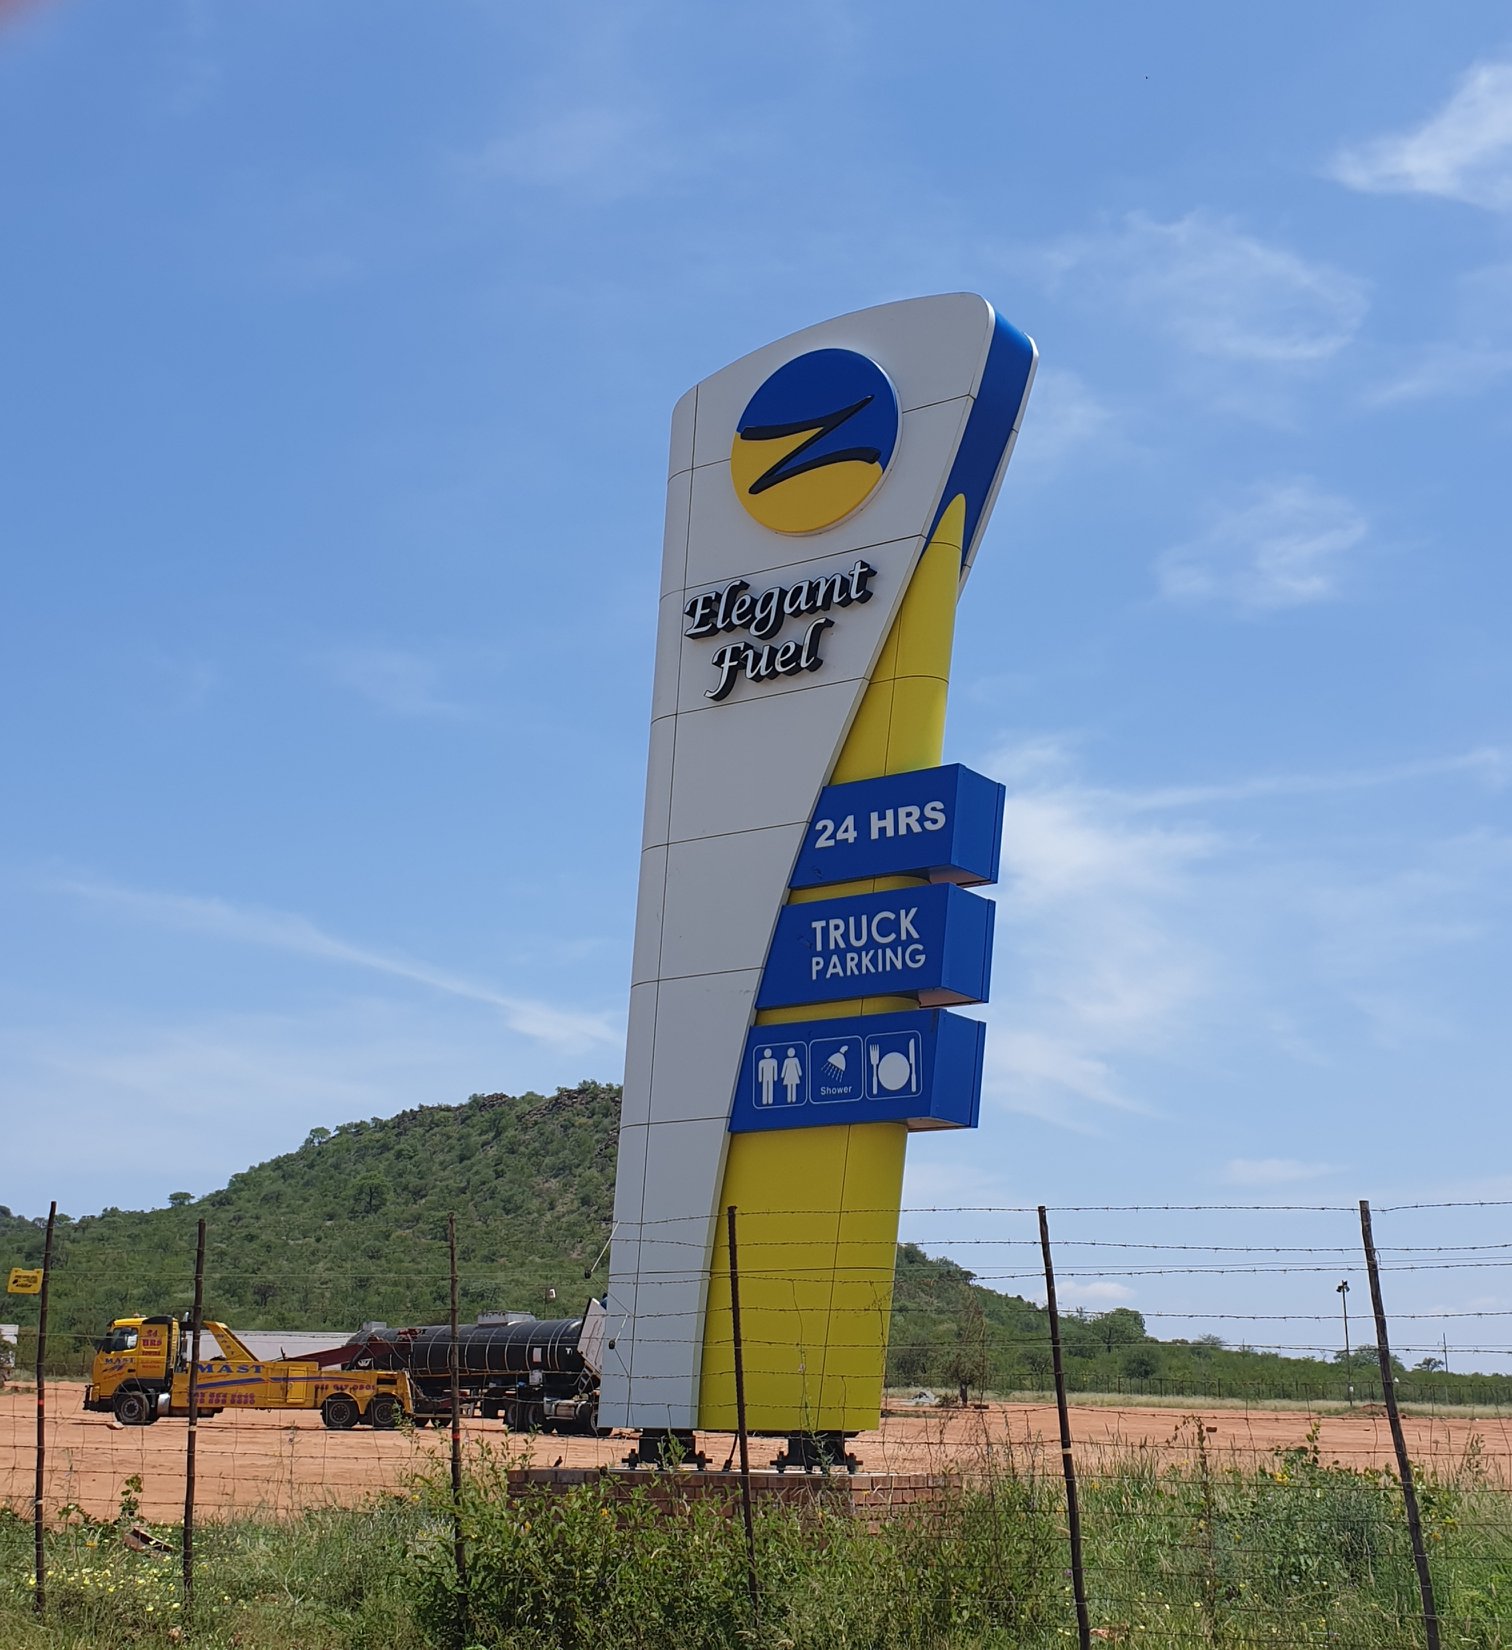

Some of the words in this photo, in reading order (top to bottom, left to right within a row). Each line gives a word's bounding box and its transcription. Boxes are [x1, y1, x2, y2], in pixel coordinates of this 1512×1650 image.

[684, 560, 877, 640] Elegant
[704, 617, 835, 701] Fuel
[815, 815, 857, 849] 24
[870, 801, 946, 840] HRS
[811, 907, 920, 951] TRUCK
[811, 944, 926, 980] PARKING
[820, 1085, 852, 1096] Shower
[142, 1339, 162, 1347] HRS
[196, 1364, 265, 1373] MAST
